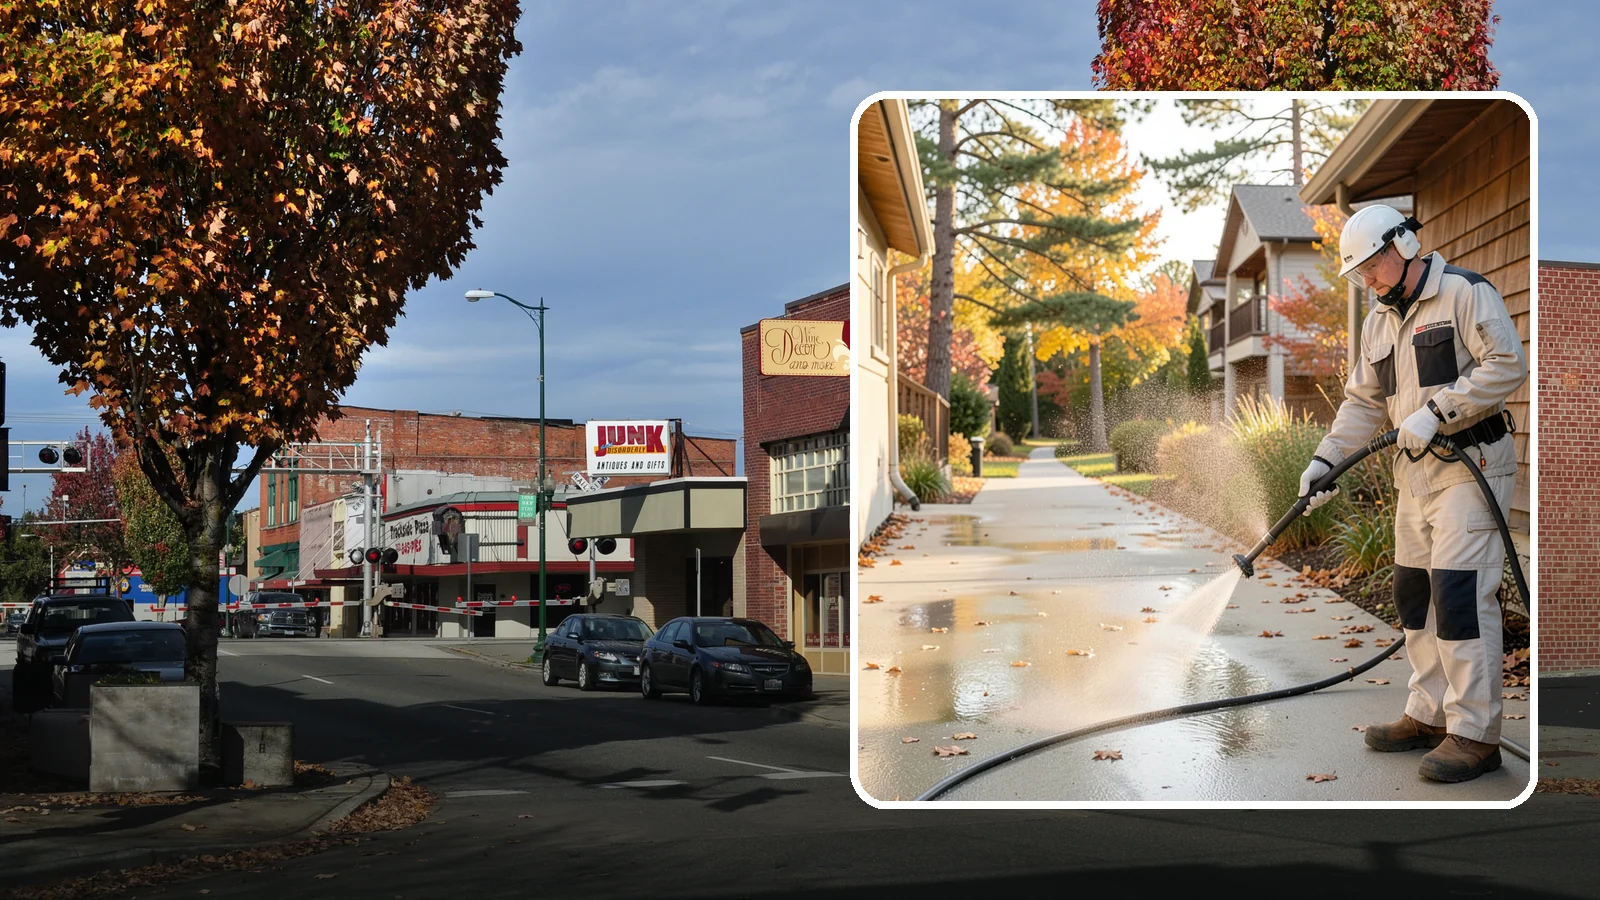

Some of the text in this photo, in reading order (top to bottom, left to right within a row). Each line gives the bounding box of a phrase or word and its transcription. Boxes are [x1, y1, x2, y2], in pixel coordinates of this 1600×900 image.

[765, 328, 830, 365] Decor
[596, 425, 665, 457] JUNK
[607, 446, 646, 454] DISORDERLY
[597, 460, 665, 470] ANTIQUES AND GIFTS
[390, 522, 413, 540] Trackside
[414, 519, 429, 535] Pizza
